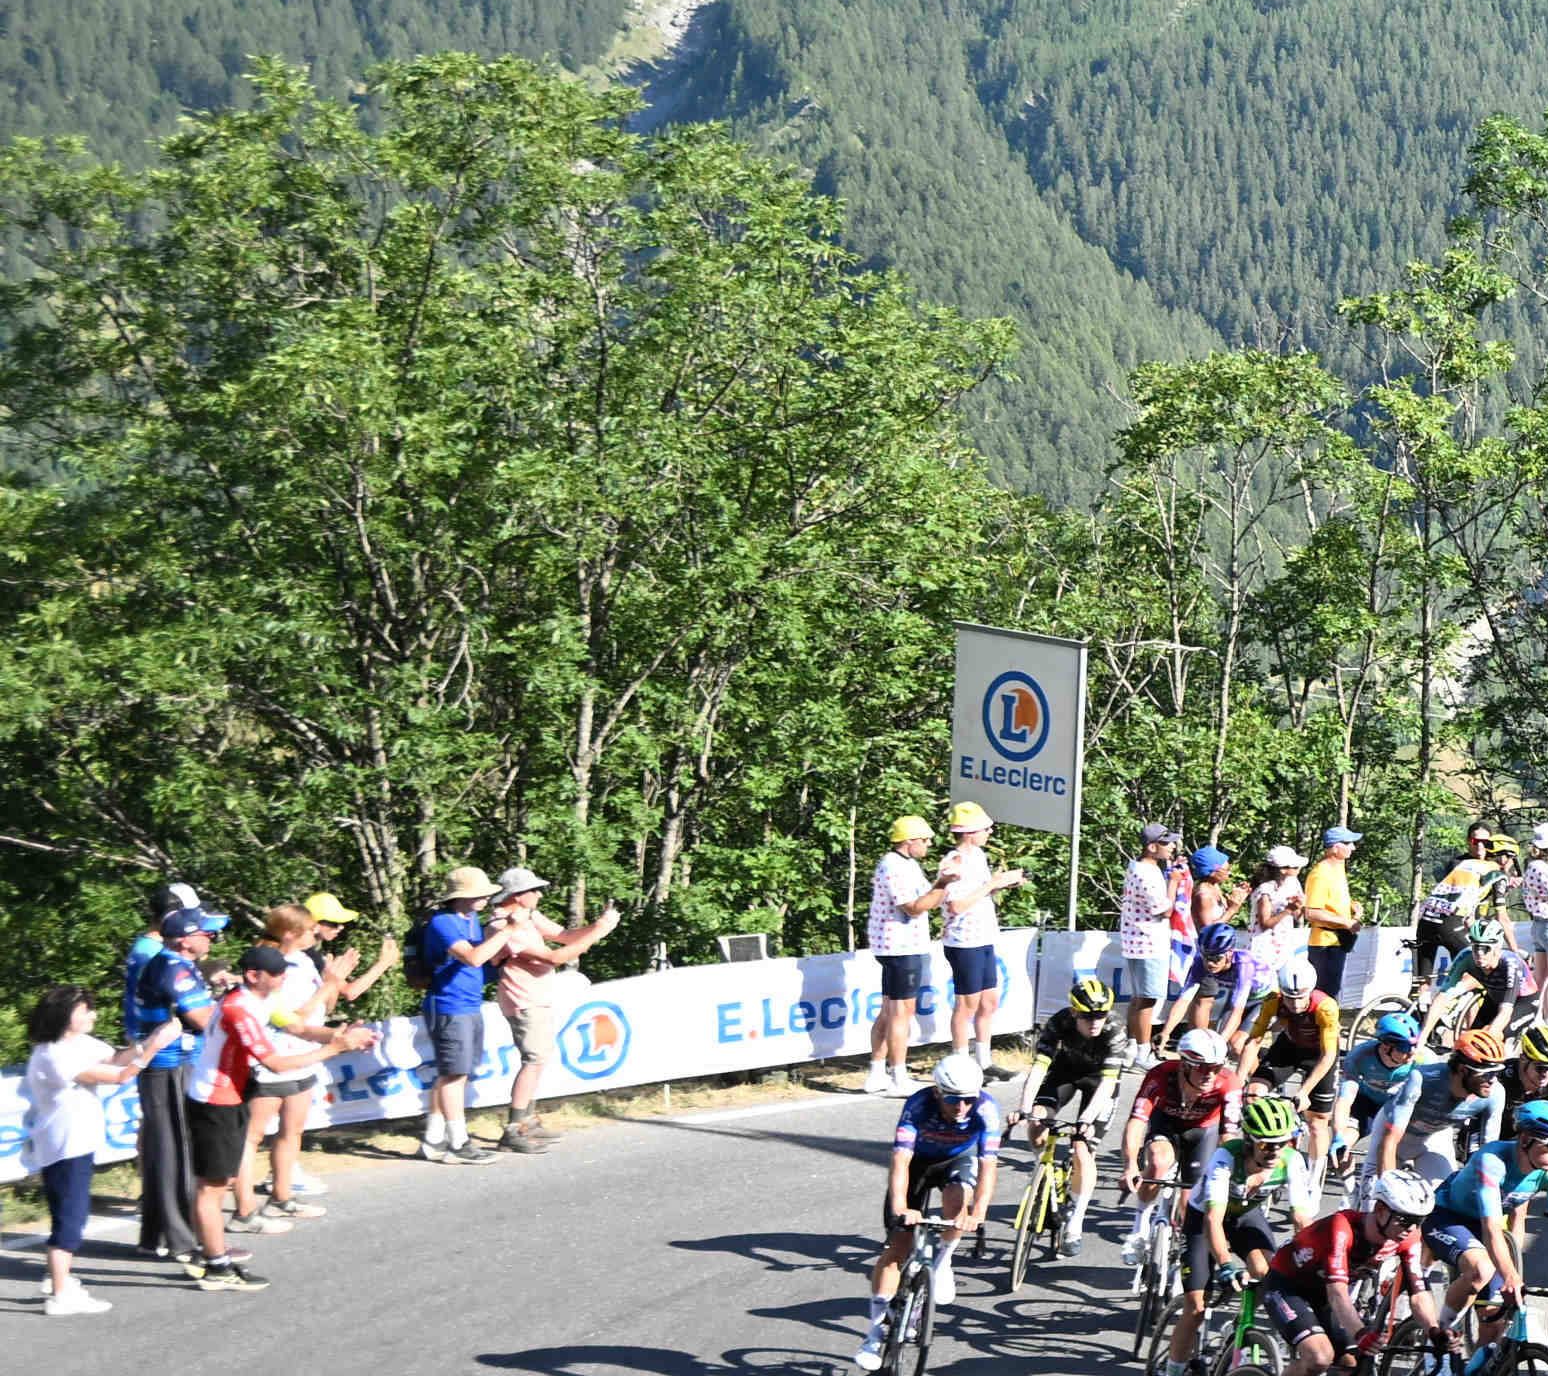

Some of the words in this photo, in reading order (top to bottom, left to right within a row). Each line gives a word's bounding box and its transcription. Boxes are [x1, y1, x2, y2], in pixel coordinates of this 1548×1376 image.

[1000, 694, 1027, 743] L
[959, 755, 1067, 796] E.Leclerc
[717, 983, 938, 1044] E.Leclec
